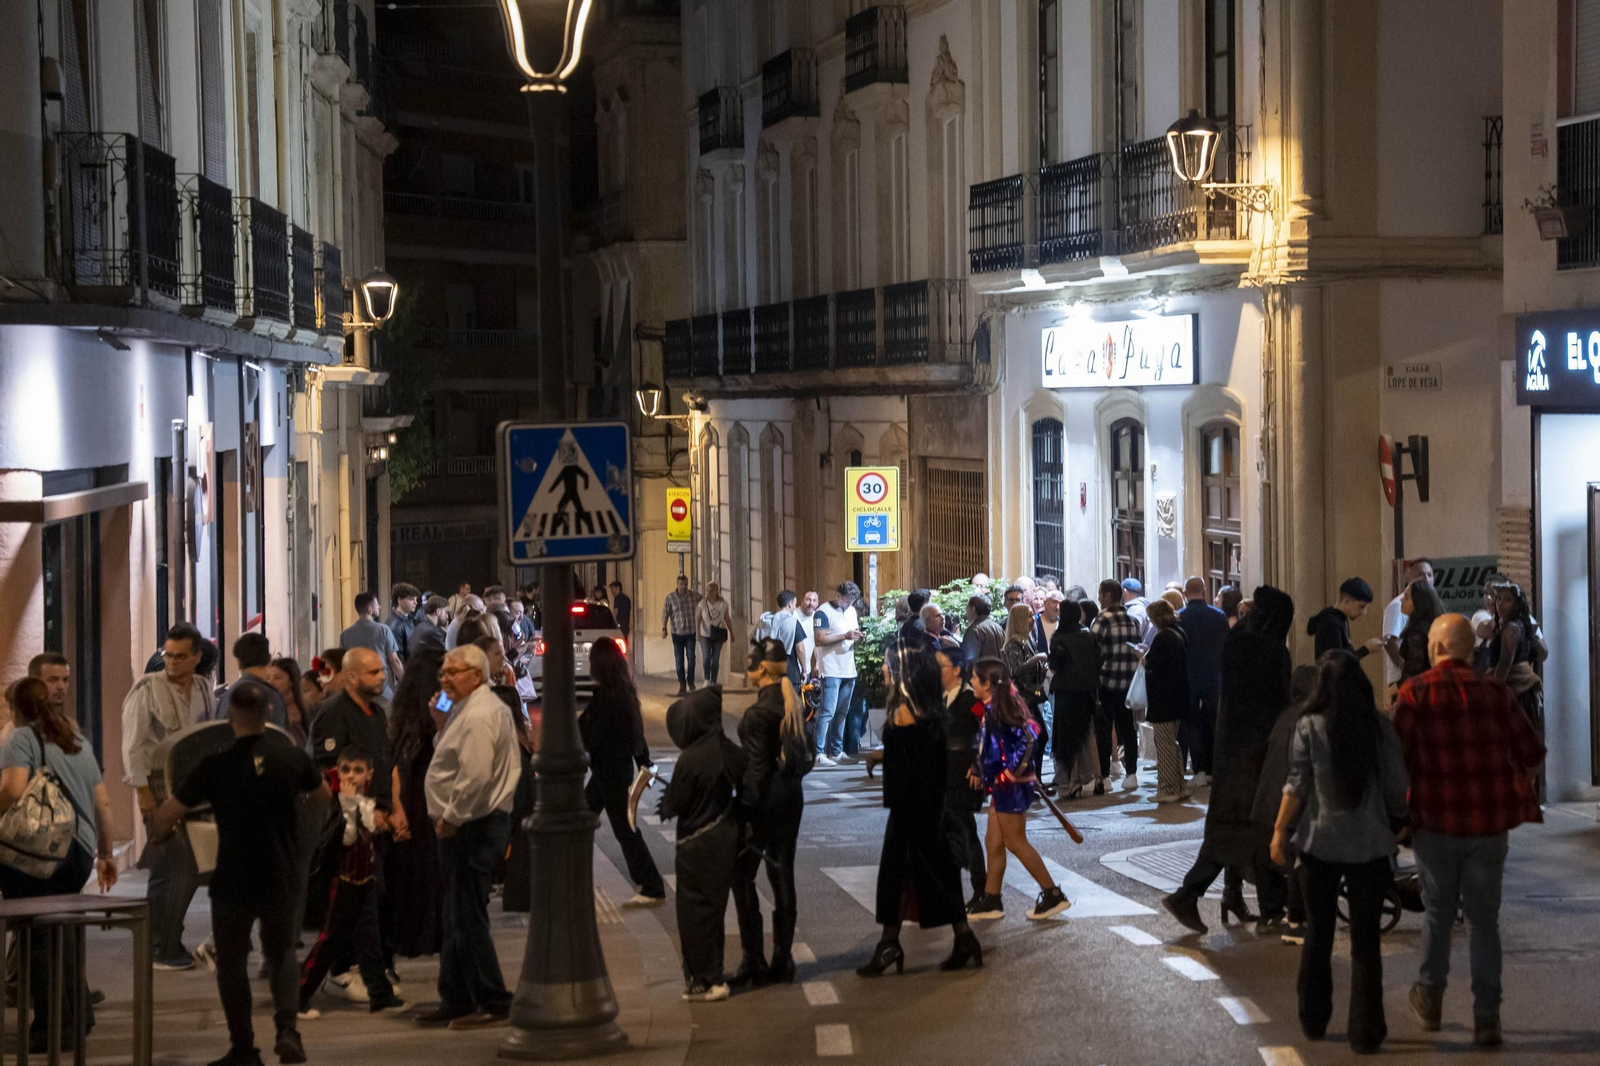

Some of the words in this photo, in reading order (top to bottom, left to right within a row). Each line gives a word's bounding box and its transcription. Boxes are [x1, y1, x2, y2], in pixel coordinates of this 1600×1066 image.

[1387, 377, 1407, 388] LOPE
[1408, 377, 1418, 388] DE
[1419, 377, 1438, 388] VEGA
[862, 483, 882, 494] 30
